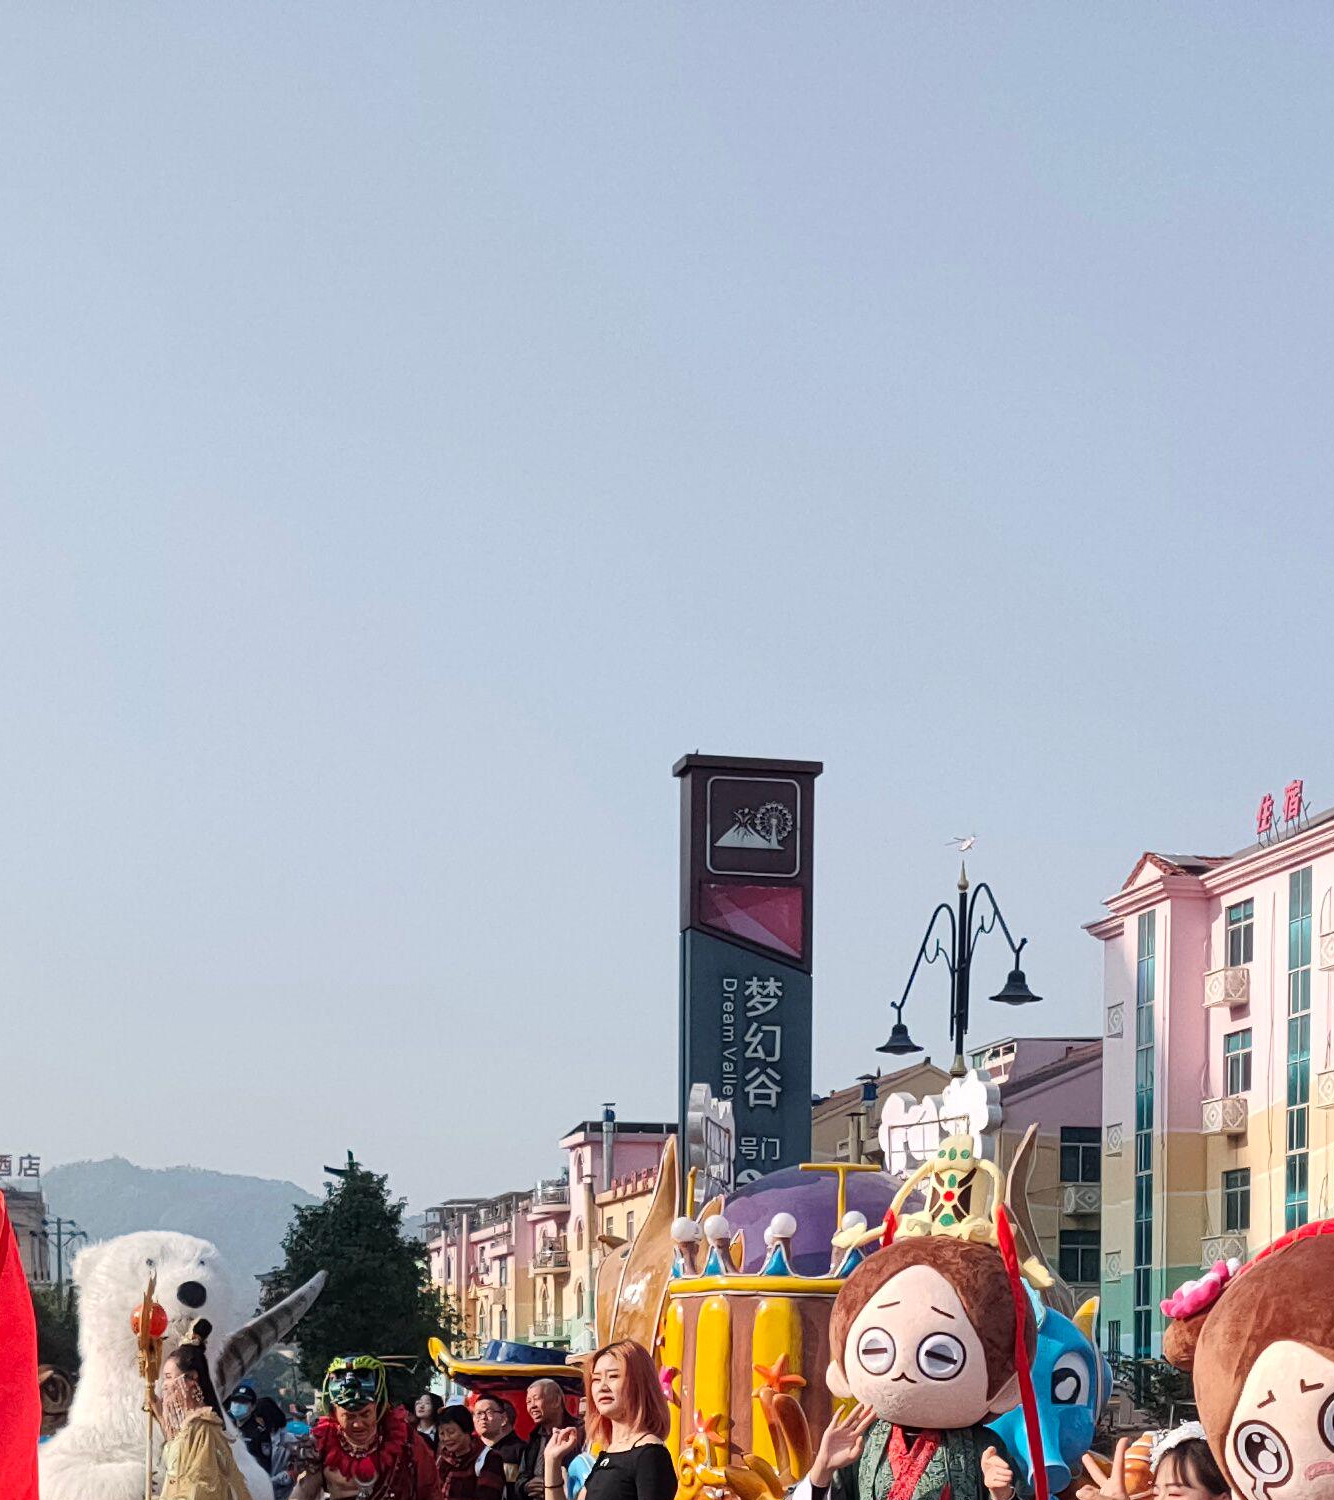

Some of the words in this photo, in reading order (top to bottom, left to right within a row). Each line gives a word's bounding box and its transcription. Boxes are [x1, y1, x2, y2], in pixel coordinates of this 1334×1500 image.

[1256, 779, 1303, 834] 住宿
[722, 978, 738, 1042] Dream
[744, 977, 782, 1107] 梦幻谷
[722, 1047, 738, 1101] Valle
[739, 1137, 780, 1160] 号门
